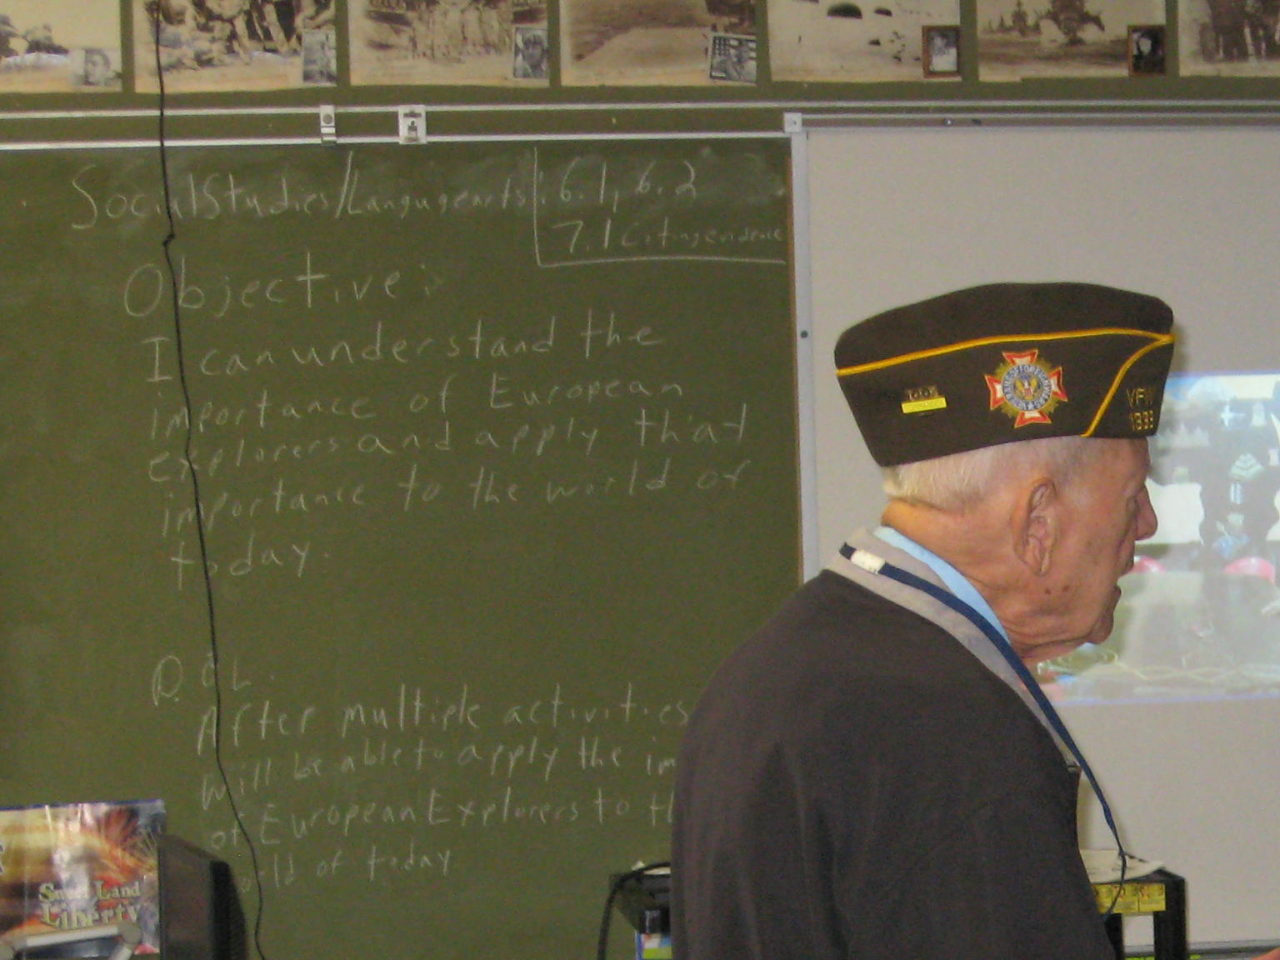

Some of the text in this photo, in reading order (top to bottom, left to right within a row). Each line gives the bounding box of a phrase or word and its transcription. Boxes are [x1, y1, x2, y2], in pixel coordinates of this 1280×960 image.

[140, 307, 665, 383] I can understand the
[408, 373, 457, 414] of
[489, 372, 683, 411] European
[356, 418, 452, 454] and
[473, 416, 599, 457] apply
[633, 401, 748, 448] that
[397, 462, 442, 512] to
[469, 465, 520, 511] the
[696, 458, 752, 492] of
[197, 699, 317, 756] After
[457, 736, 559, 783] apply
[578, 735, 623, 770] the
[260, 801, 418, 846] European
[593, 786, 631, 825] to
[41, 898, 143, 932] Liberty
[94, 879, 142, 901] Land
